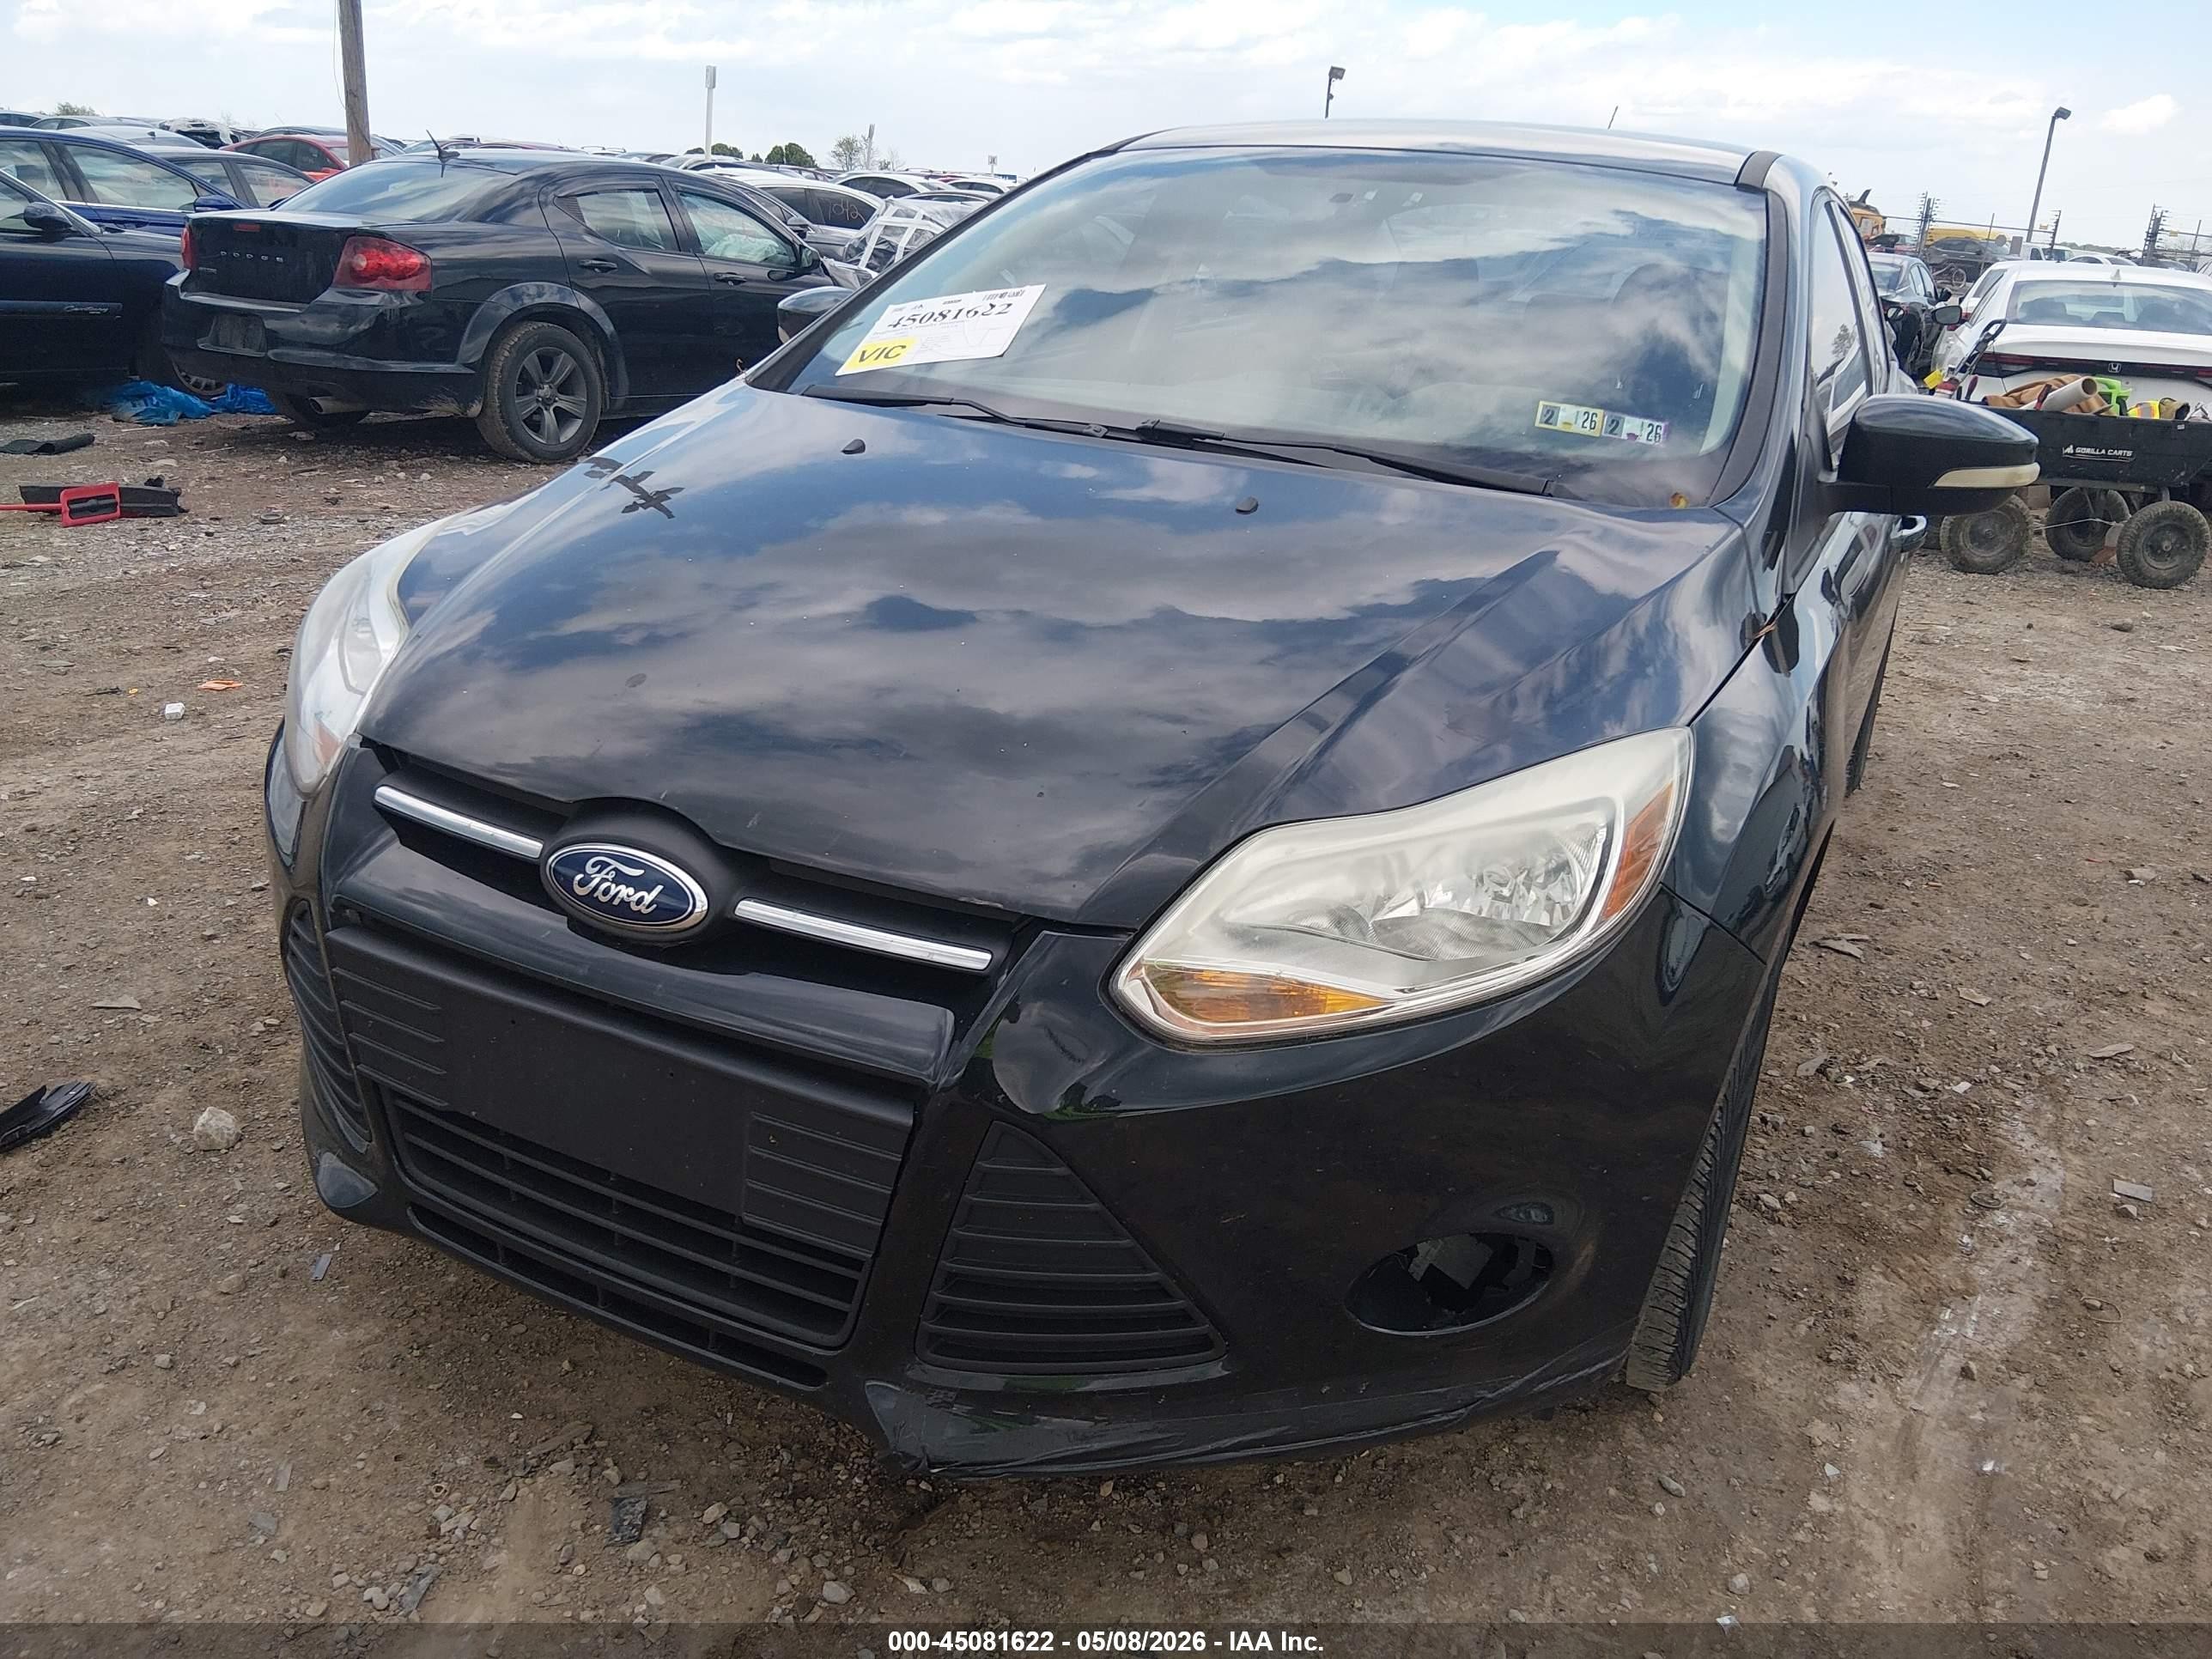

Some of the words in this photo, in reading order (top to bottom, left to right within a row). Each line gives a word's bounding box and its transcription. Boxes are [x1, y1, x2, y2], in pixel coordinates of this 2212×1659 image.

[220, 251, 283, 263] DODGE
[886, 301, 1014, 329] 45081622
[858, 344, 907, 363] VIC
[1543, 409, 1555, 425] 2
[1581, 410, 1598, 430] 26
[1607, 418, 1620, 435] 2
[1646, 422, 1662, 443] 26
[2075, 447, 2106, 455] GORILLA
[573, 855, 665, 915] Ford
